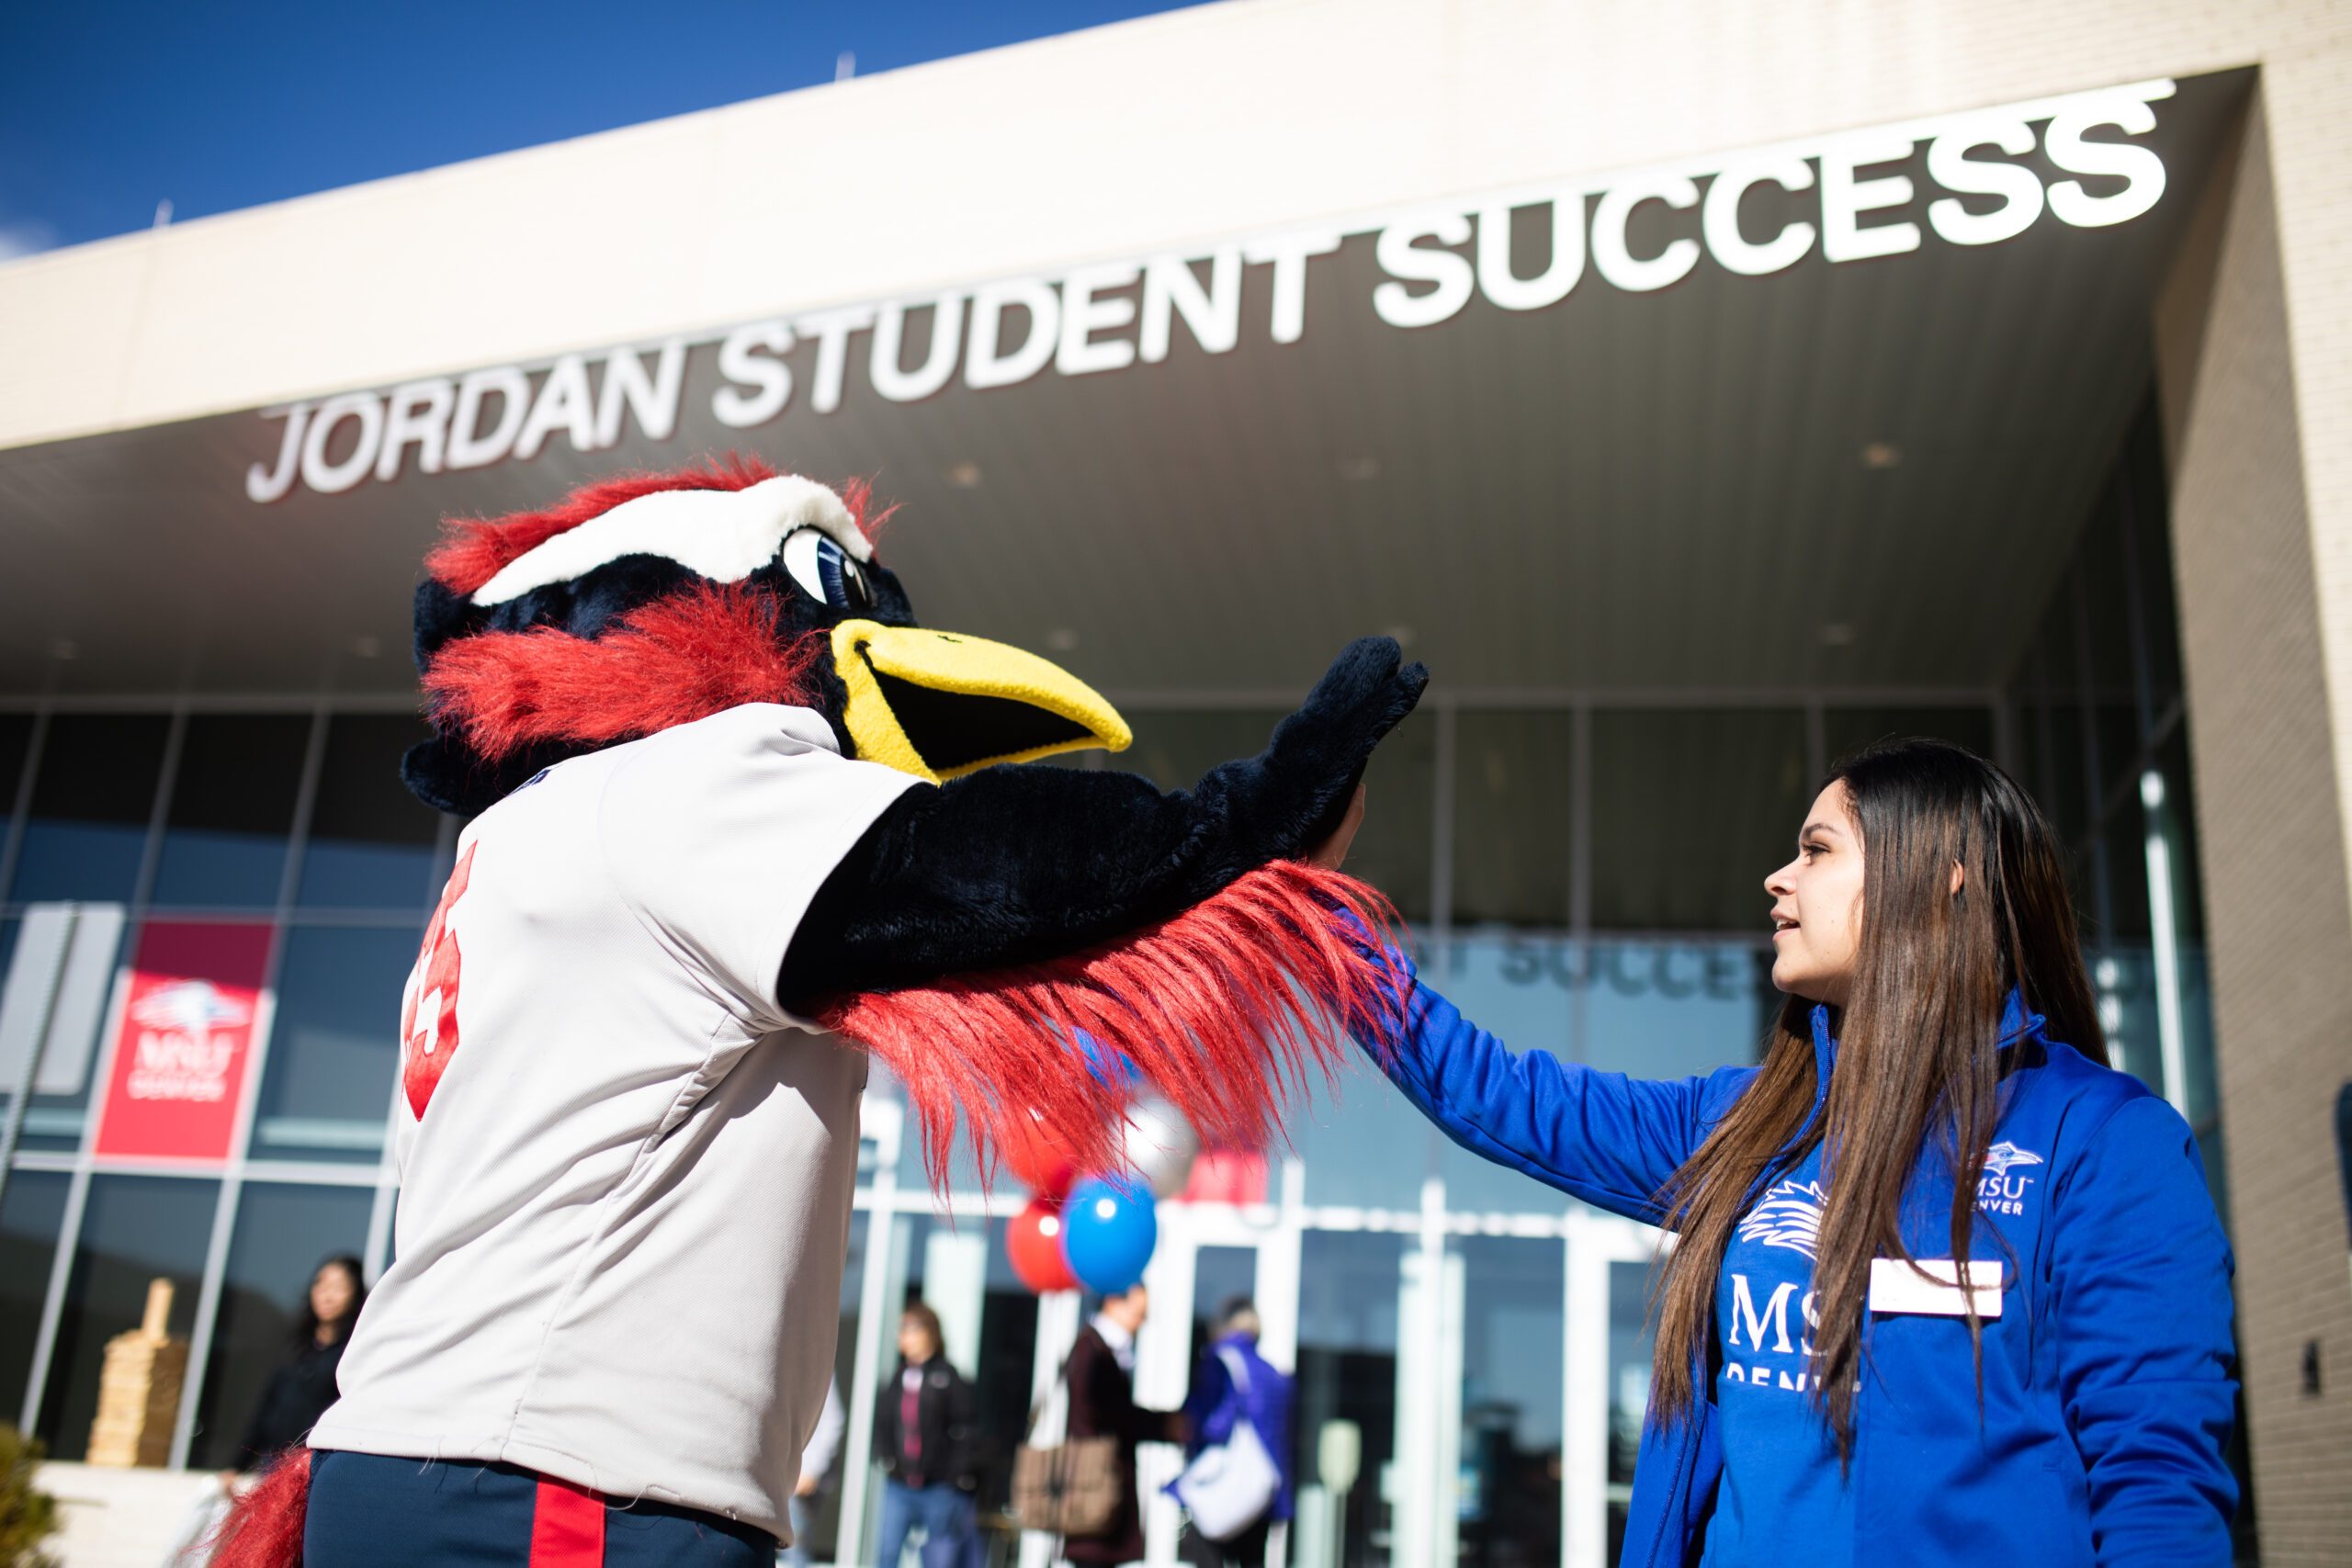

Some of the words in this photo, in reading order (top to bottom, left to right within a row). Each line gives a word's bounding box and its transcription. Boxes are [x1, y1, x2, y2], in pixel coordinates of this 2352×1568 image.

[245, 336, 687, 503] JORDAN
[711, 231, 1341, 427] STUDENT
[1373, 90, 2168, 328] SUCCESS
